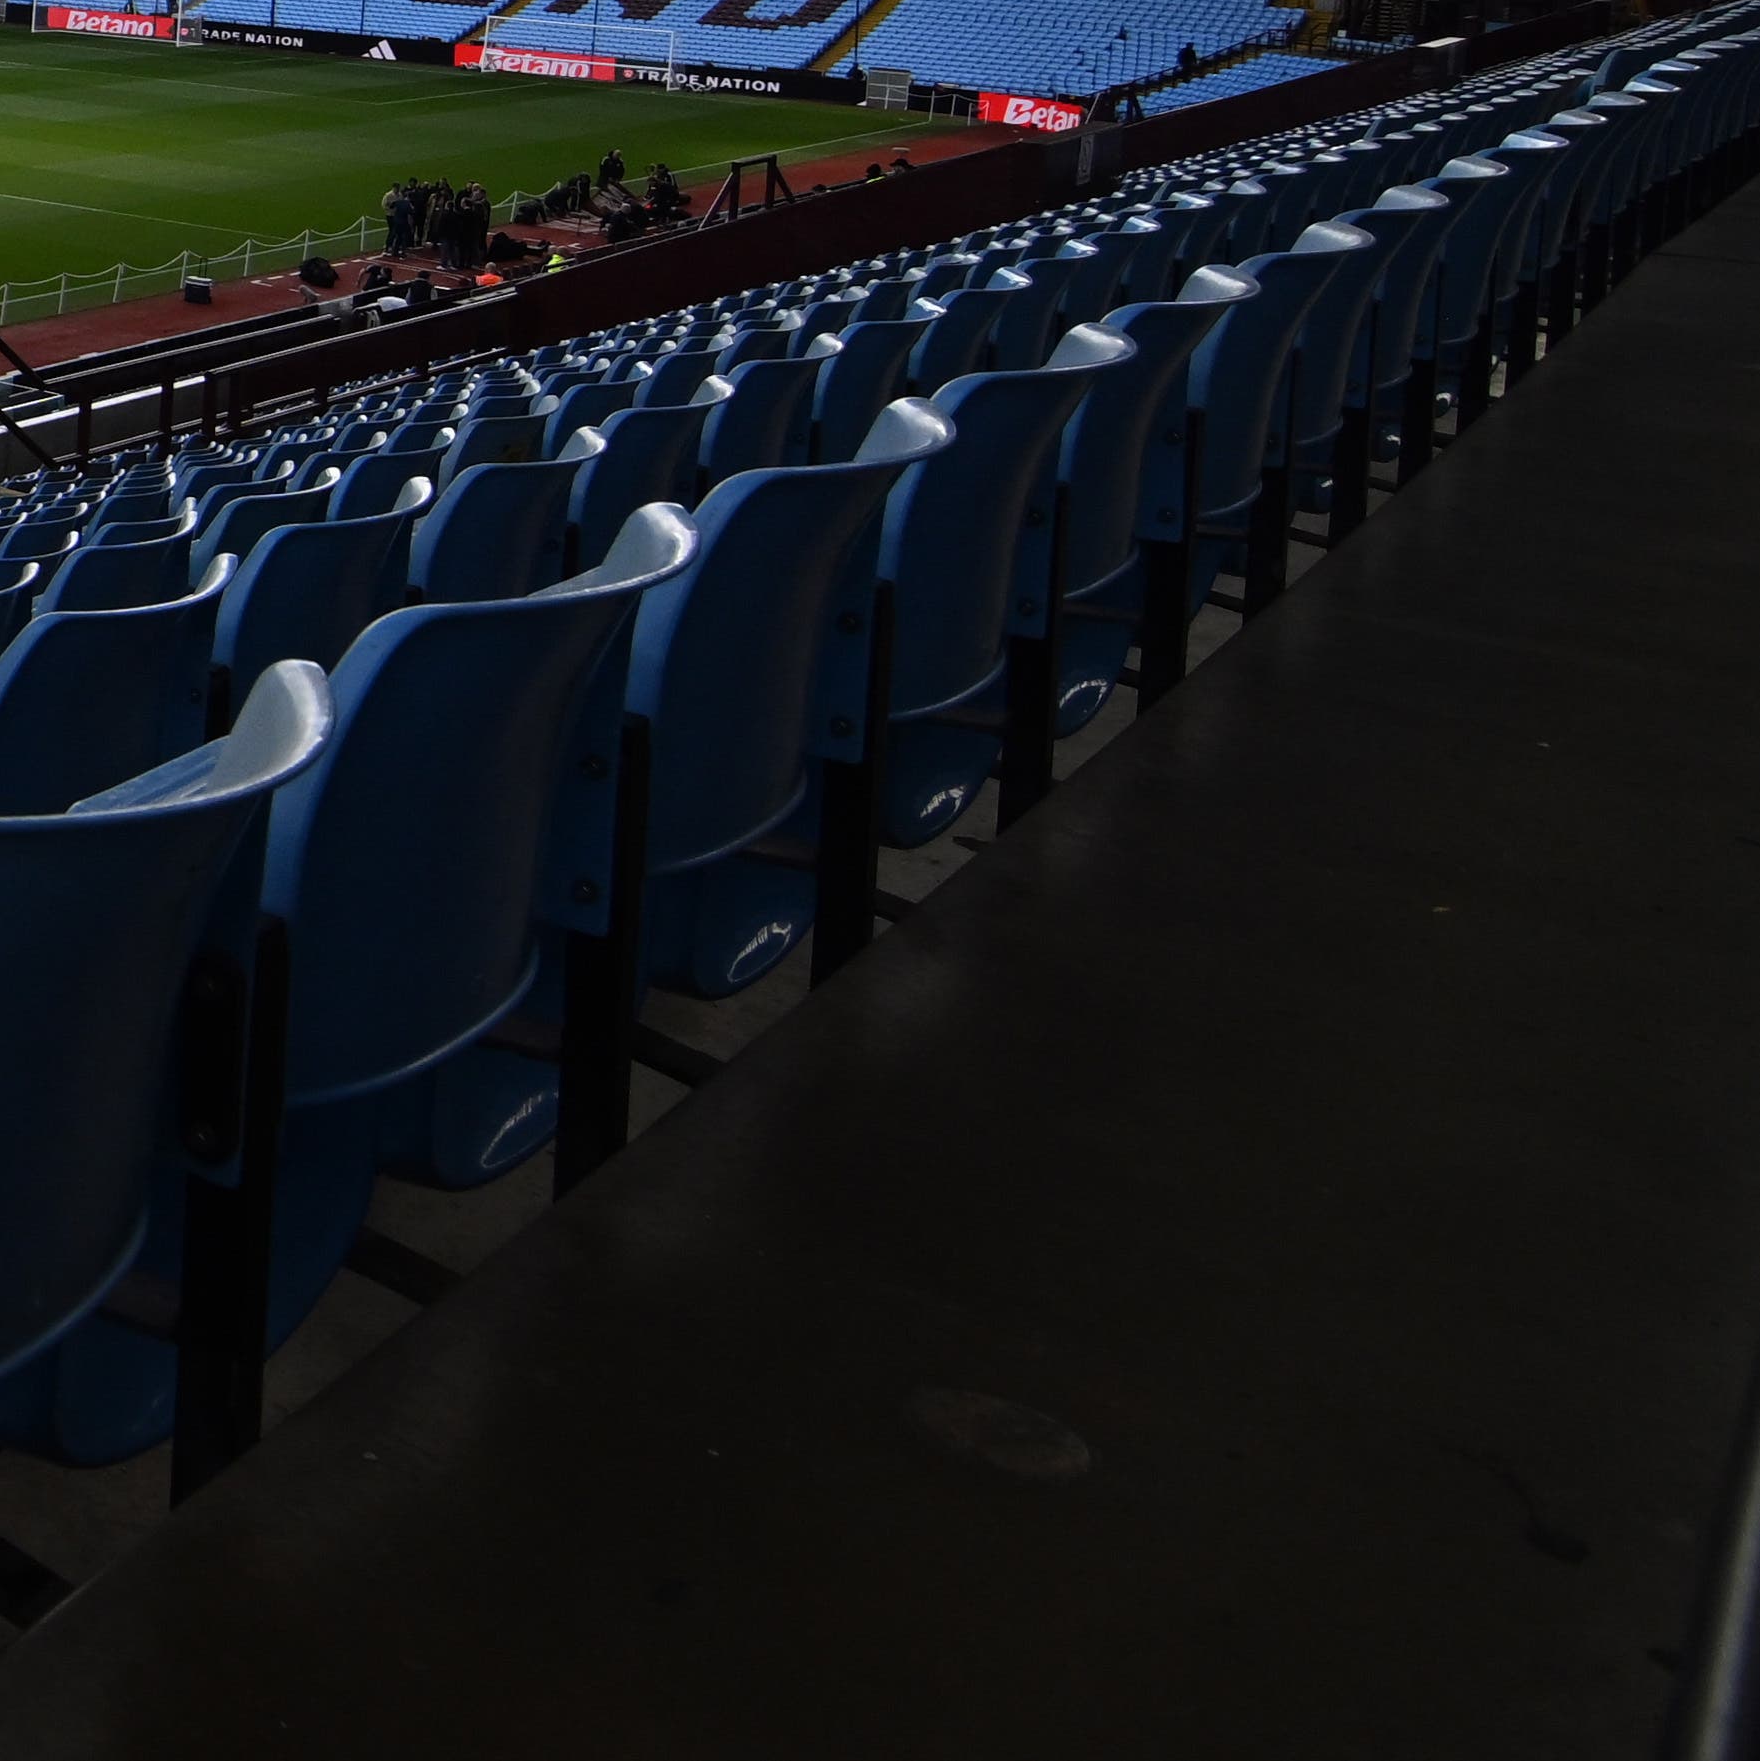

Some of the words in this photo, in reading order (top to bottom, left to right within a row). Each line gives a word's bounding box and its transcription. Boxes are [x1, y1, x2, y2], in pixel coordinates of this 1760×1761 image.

[66, 11, 155, 38] Betano
[245, 32, 304, 49] NATION
[636, 68, 698, 86] TRADE
[705, 74, 781, 94] NATION
[1003, 97, 1081, 133] Betan
